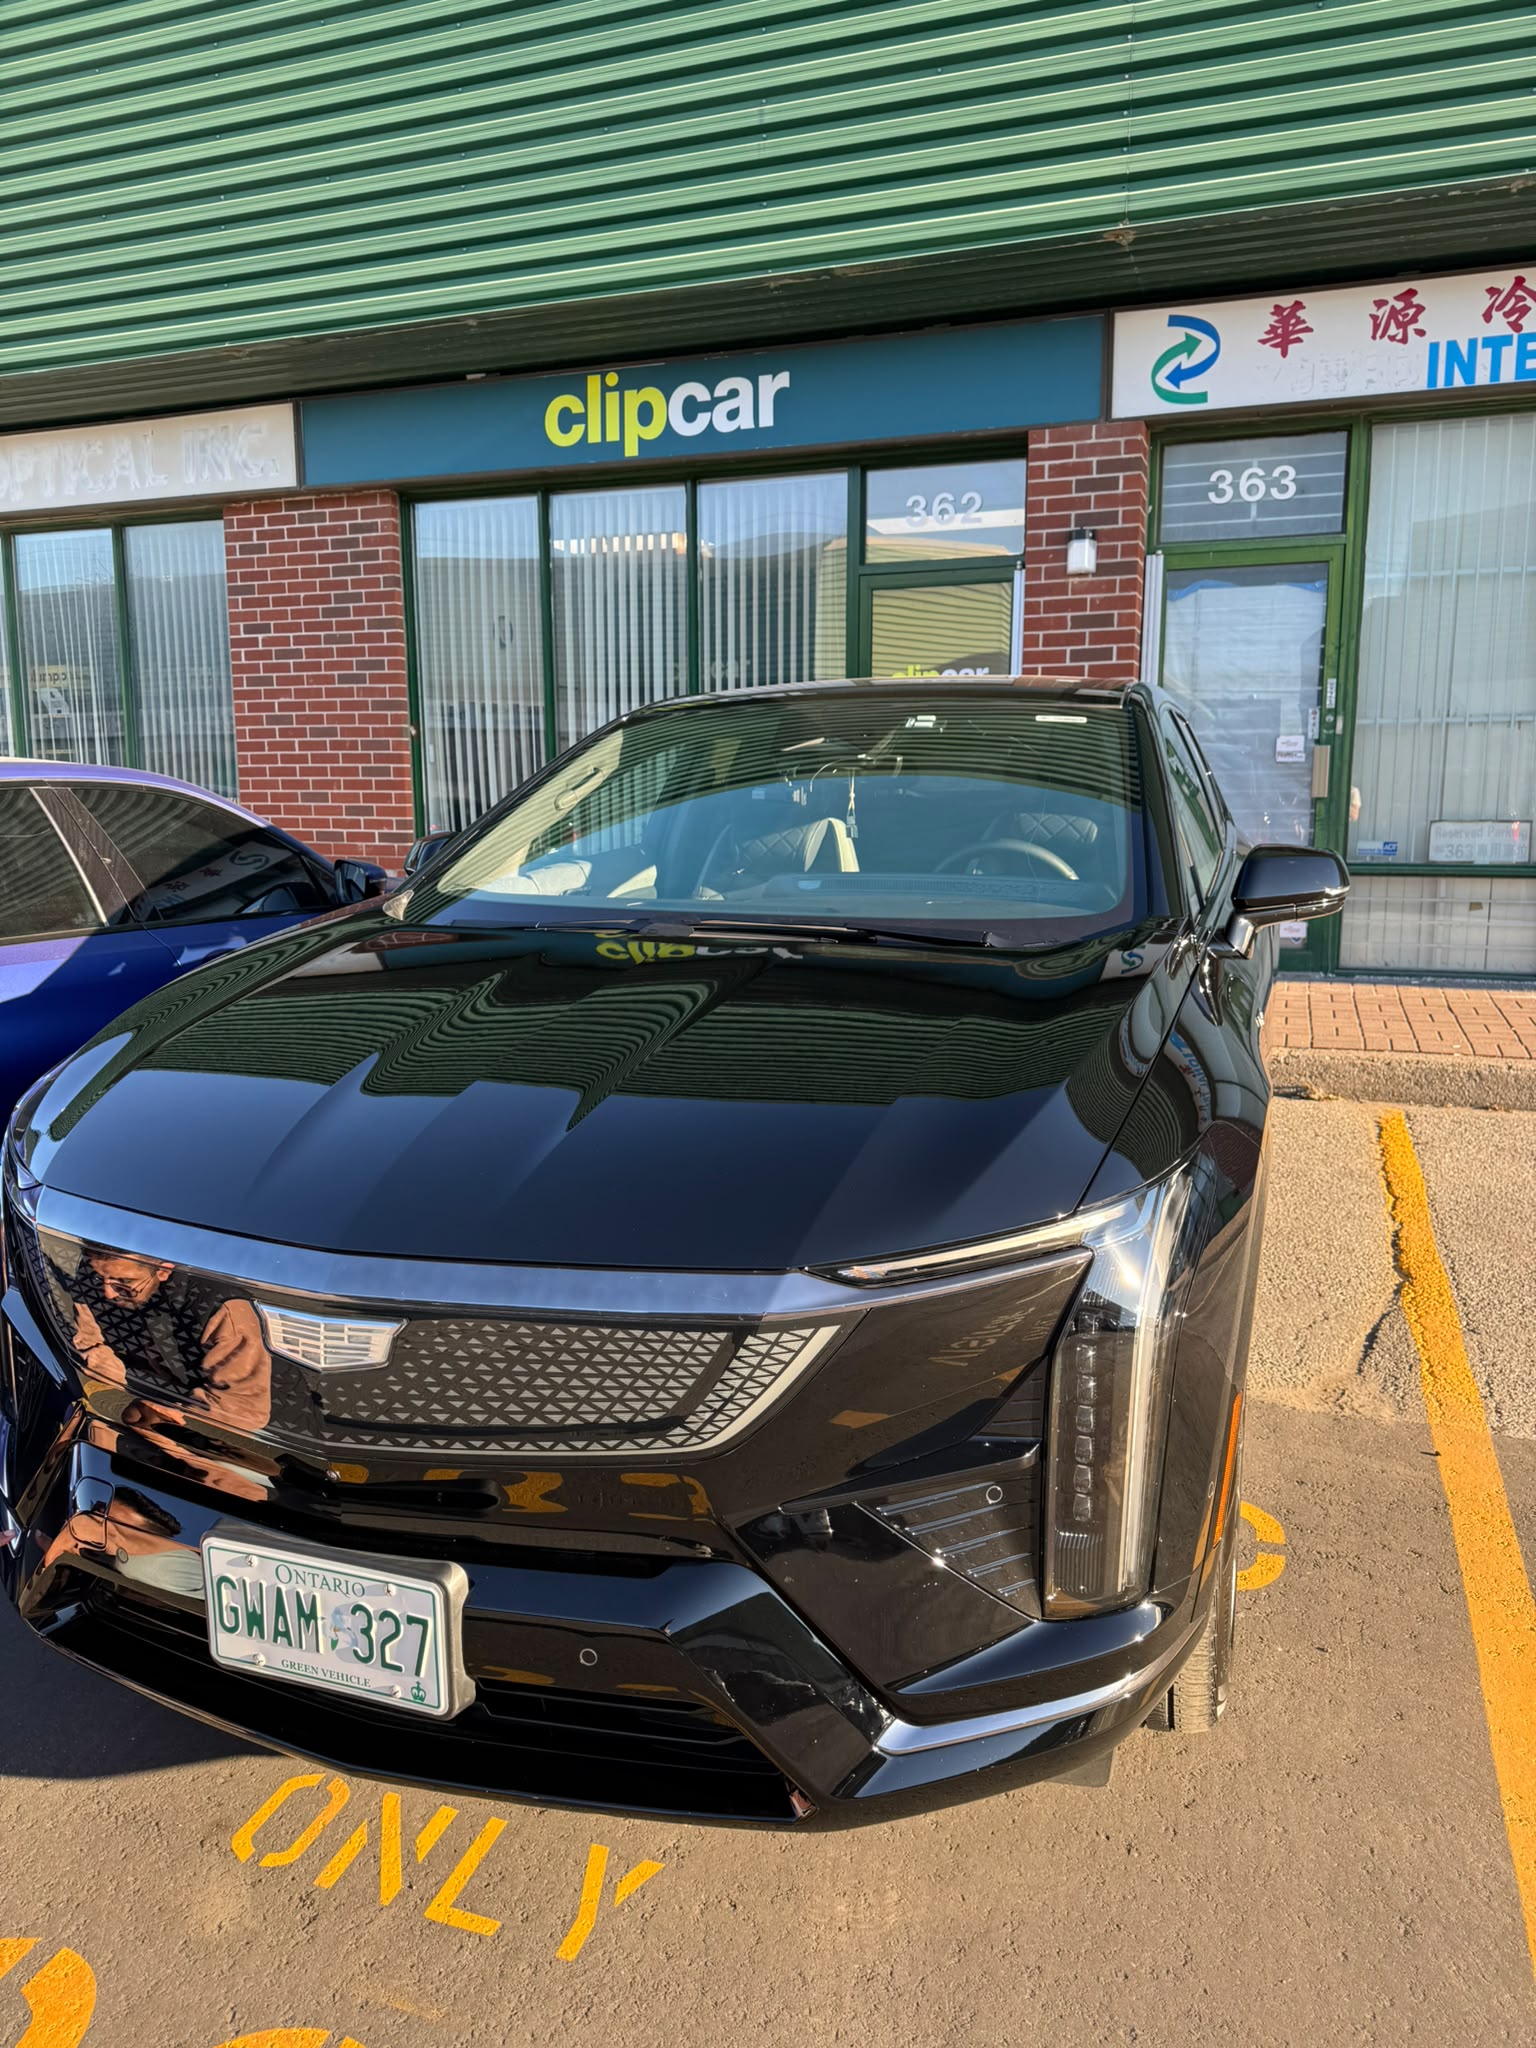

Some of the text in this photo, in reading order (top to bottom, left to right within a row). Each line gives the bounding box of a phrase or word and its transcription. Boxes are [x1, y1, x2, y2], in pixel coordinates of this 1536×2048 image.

[1427, 332, 1536, 389] INTE
[544, 371, 791, 457] clipcar
[1208, 465, 1298, 504] 363
[905, 492, 983, 528] 362
[275, 1563, 366, 1597] ONTARIO
[215, 1575, 431, 1678] GWAM 327
[281, 1660, 371, 1688] GREEN VEHICLE
[231, 1773, 665, 1962] ONLY
